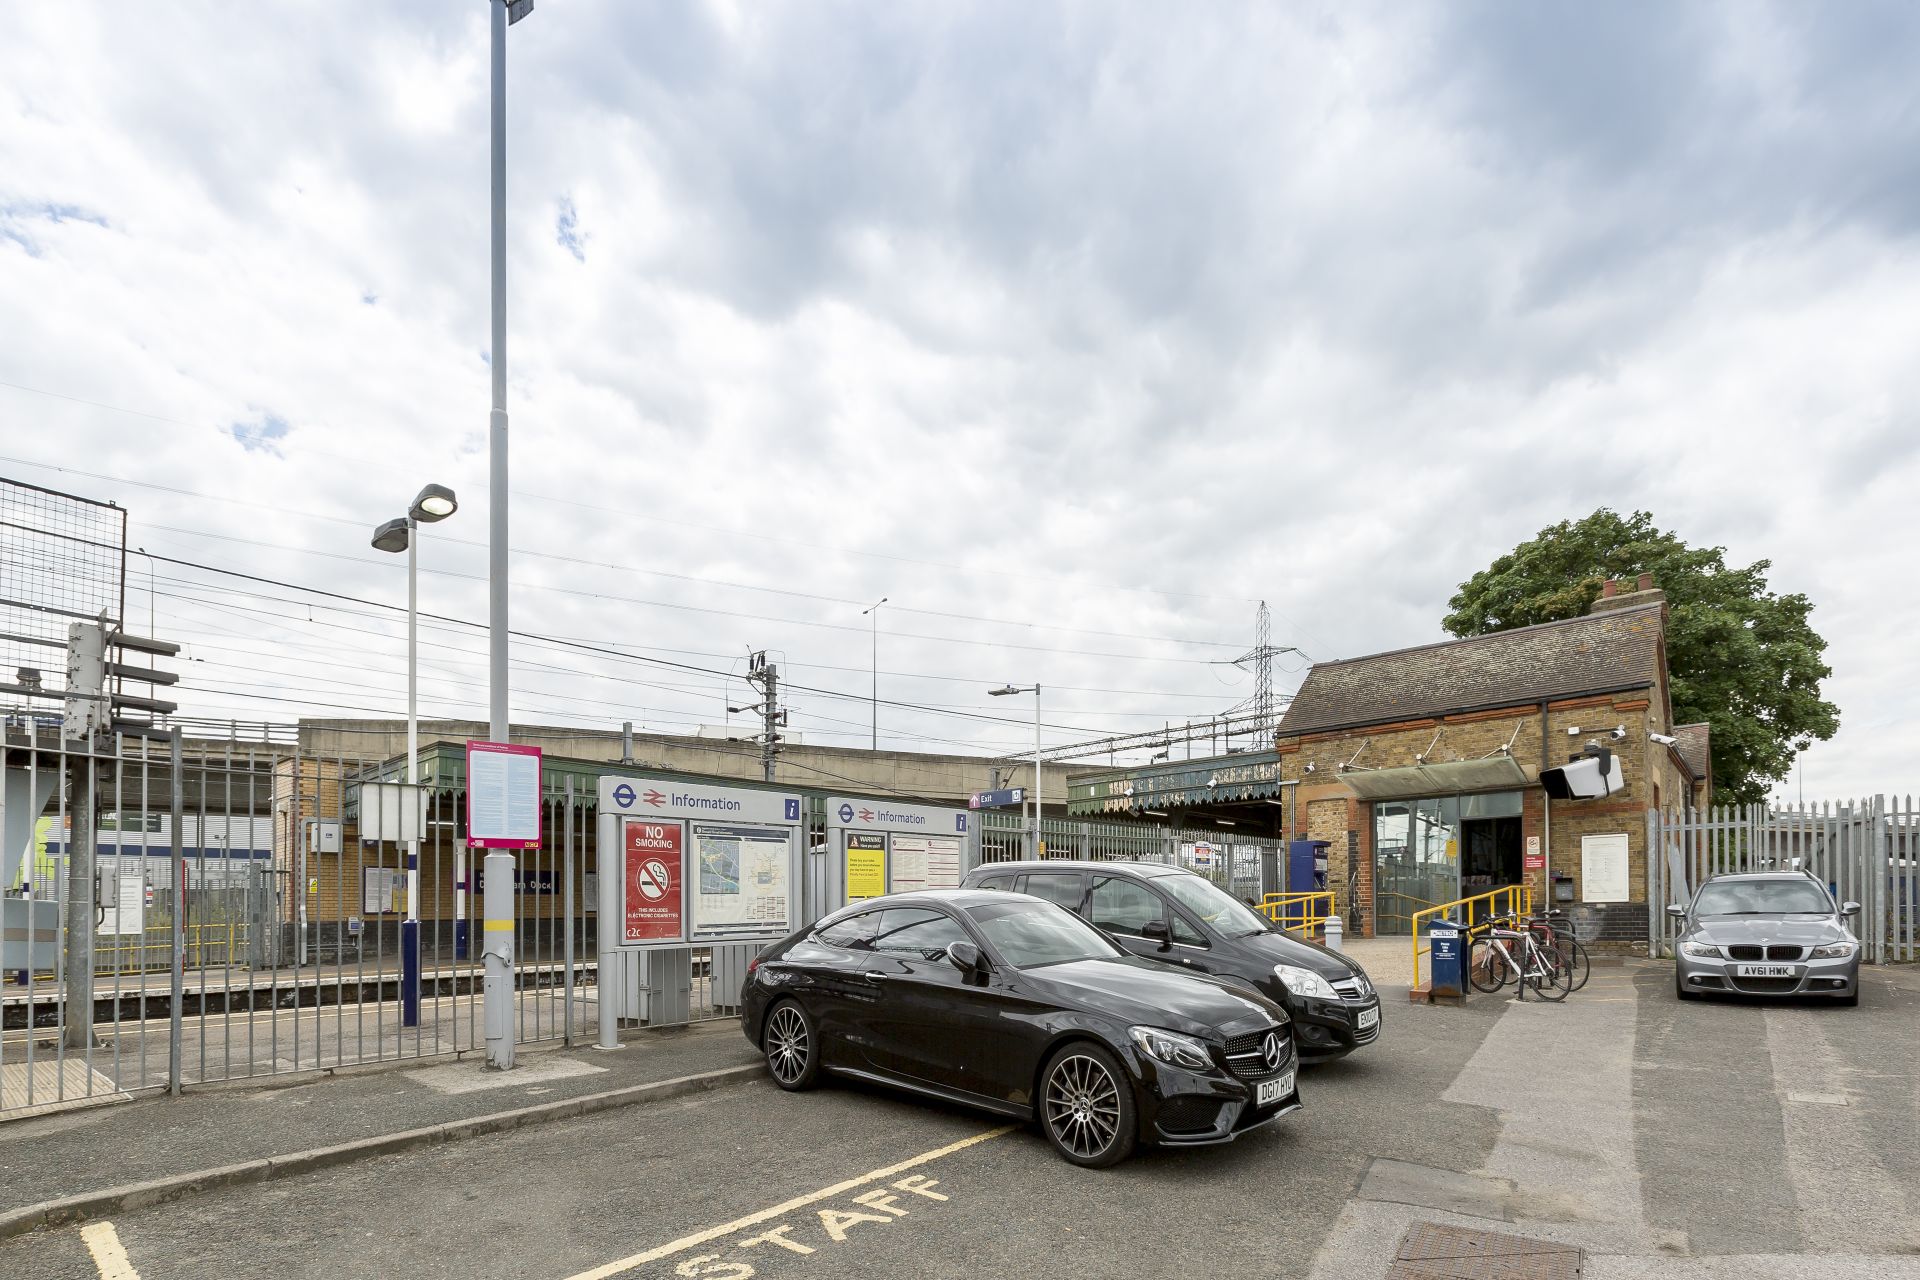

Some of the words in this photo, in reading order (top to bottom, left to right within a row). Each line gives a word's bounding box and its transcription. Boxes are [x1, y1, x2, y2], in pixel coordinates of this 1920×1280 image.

[671, 793, 740, 811] Information
[980, 795, 992, 803] Exit
[877, 810, 926, 825] Information
[645, 826, 664, 839] NO
[635, 838, 673, 848] SMOKING
[627, 928, 641, 937] c2c
[1744, 967, 1766, 976] AV61
[1769, 967, 1789, 976] HWK
[1262, 1080, 1279, 1101] DG17
[675, 1175, 949, 1280] STAFF
